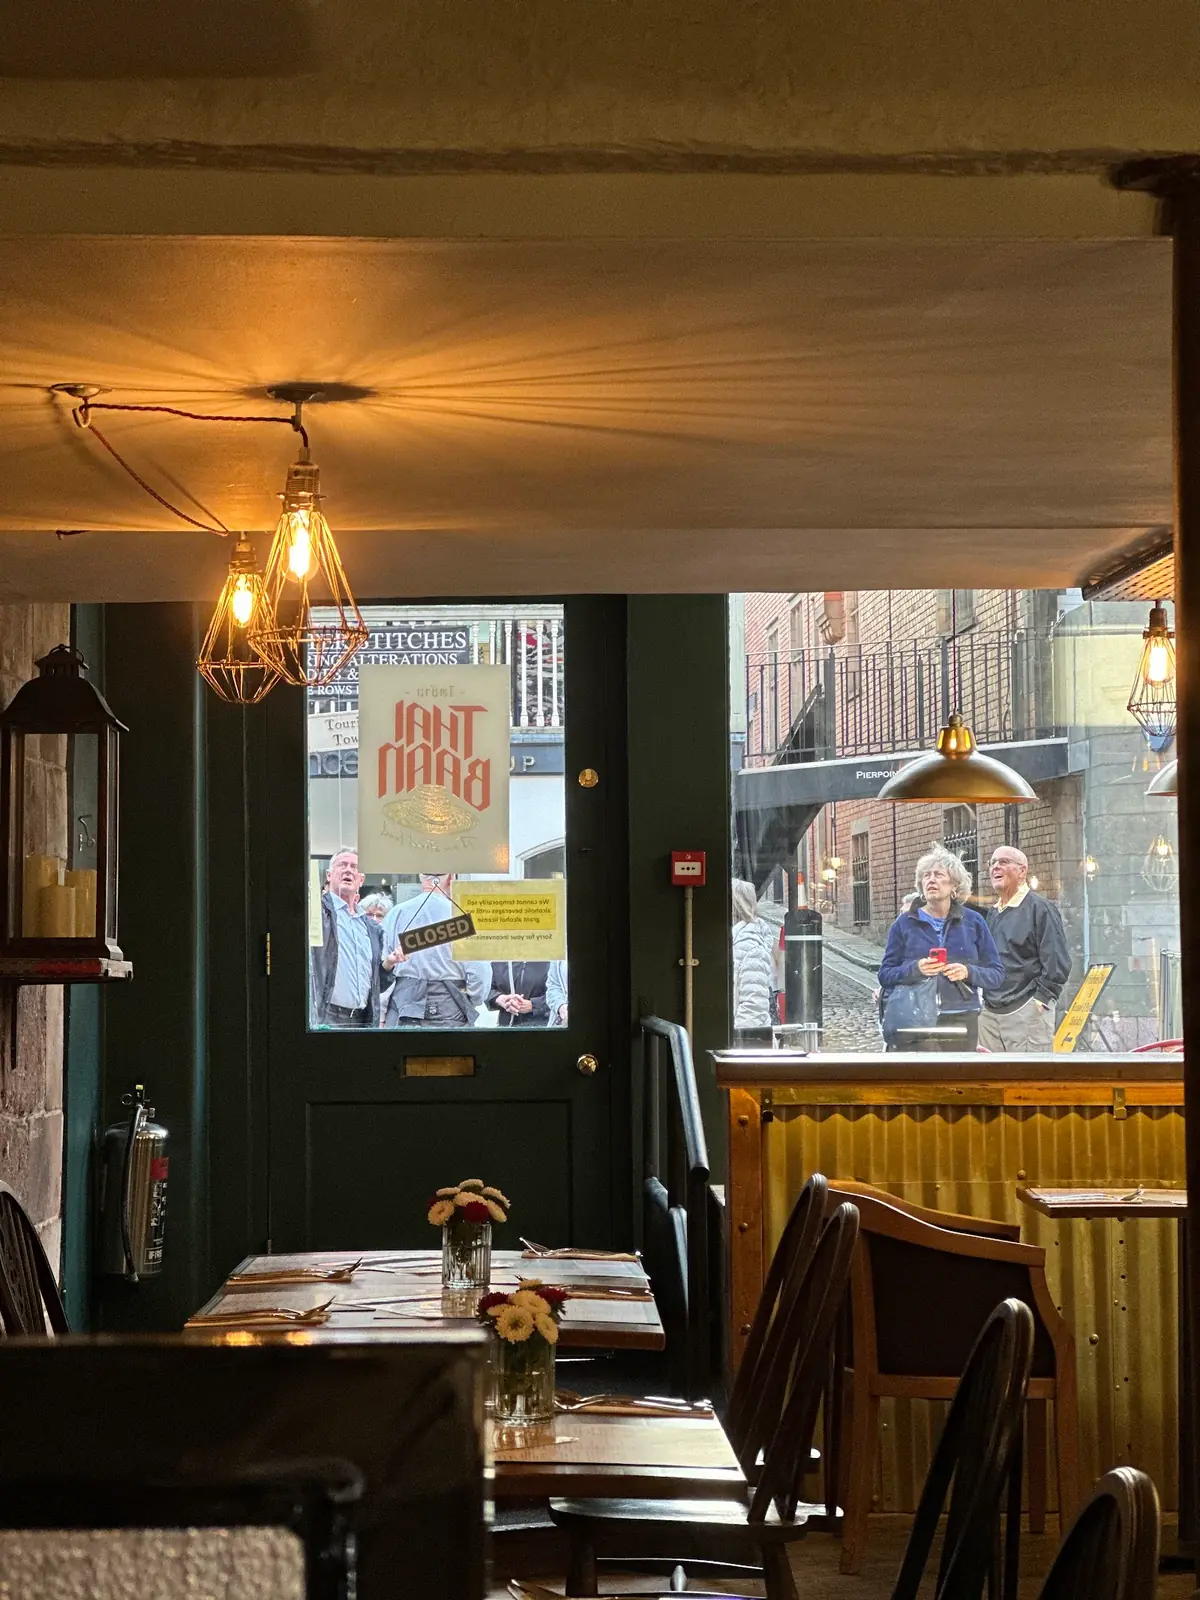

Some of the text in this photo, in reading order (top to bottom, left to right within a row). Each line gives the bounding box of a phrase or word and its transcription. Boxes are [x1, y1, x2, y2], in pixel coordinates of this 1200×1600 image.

[348, 653, 458, 665] ALTERATIONS
[318, 685, 353, 695] ROWS
[404, 919, 470, 949] CLOSED
